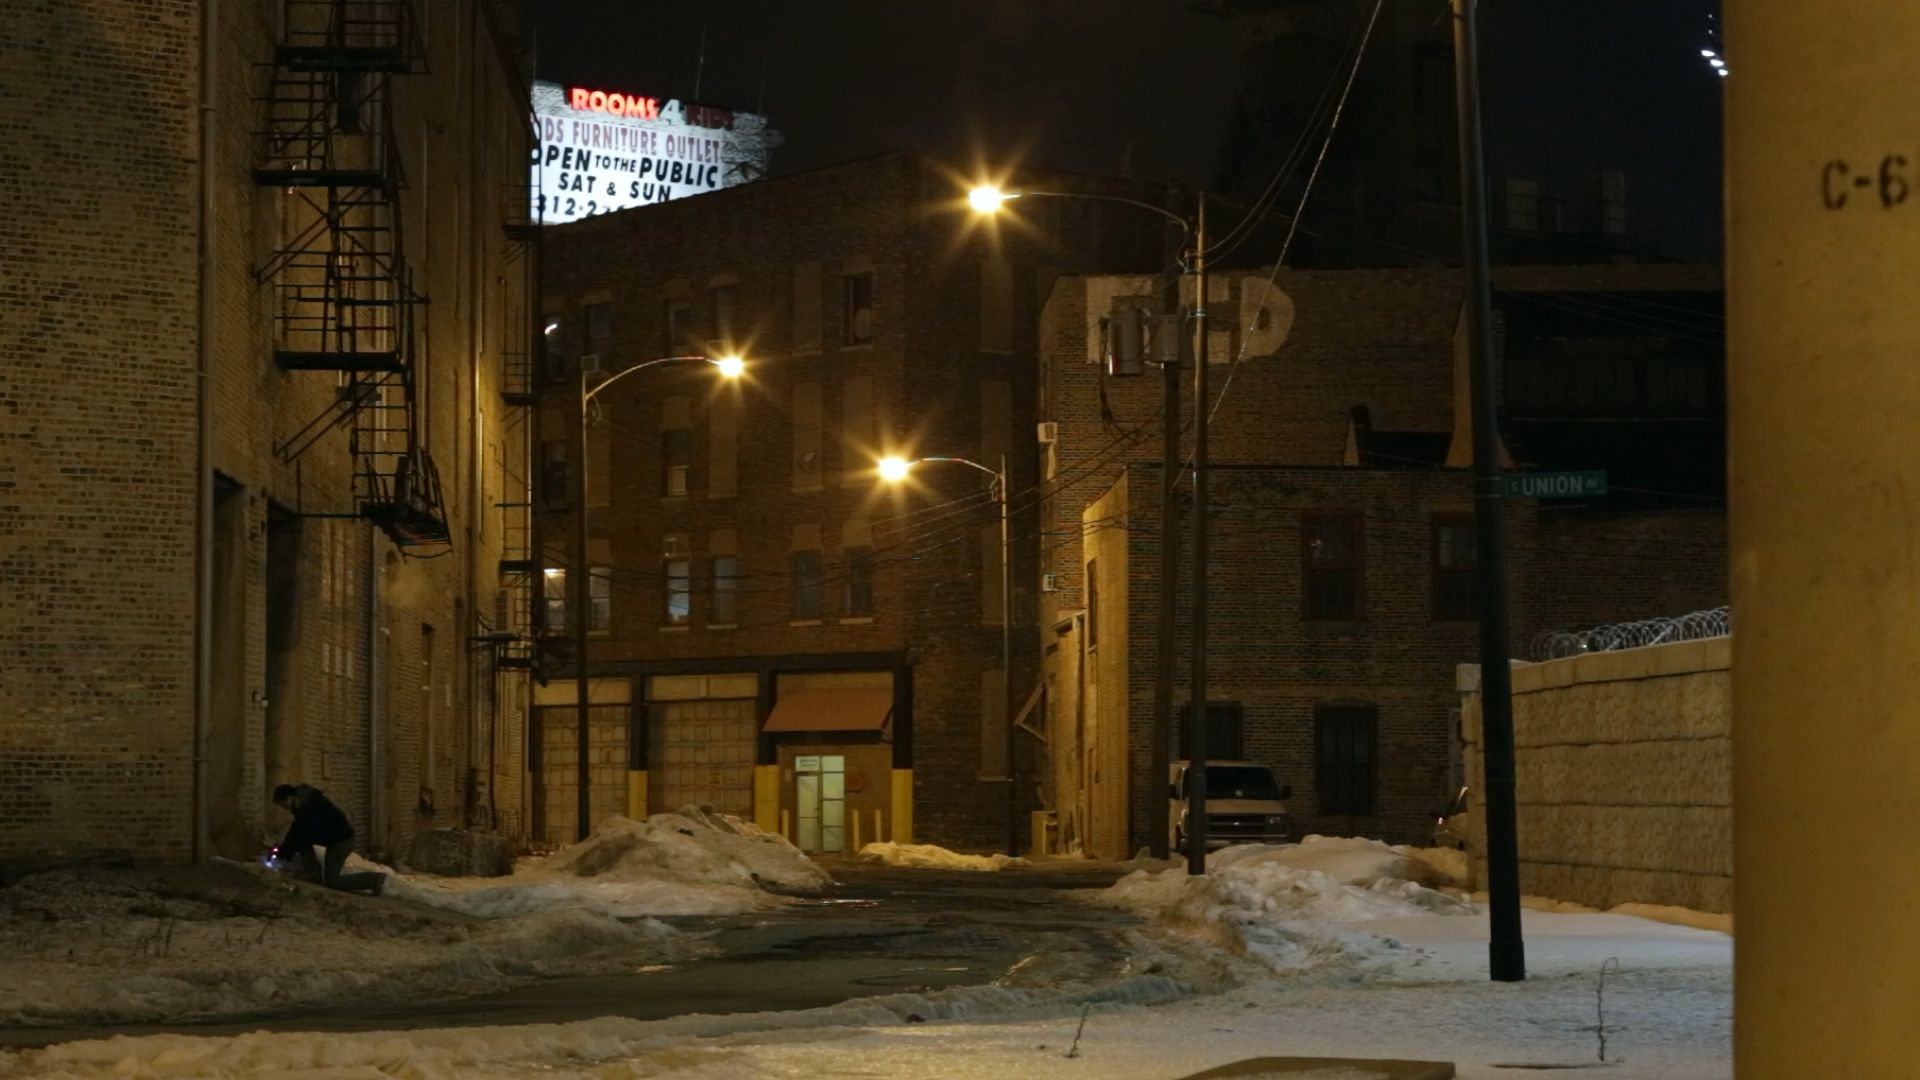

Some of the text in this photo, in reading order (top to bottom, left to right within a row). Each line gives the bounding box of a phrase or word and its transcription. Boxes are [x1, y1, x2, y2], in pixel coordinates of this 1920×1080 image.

[571, 87, 659, 120] ROOMS
[659, 98, 685, 126] 4
[573, 121, 657, 155] FURNITURE
[666, 134, 720, 163] OUTLET
[530, 145, 719, 188] OPEN TO THE PUBLIC
[558, 172, 672, 201] SAT & SUN
[1822, 154, 1910, 211] C-6
[1522, 476, 1583, 496] UNION
